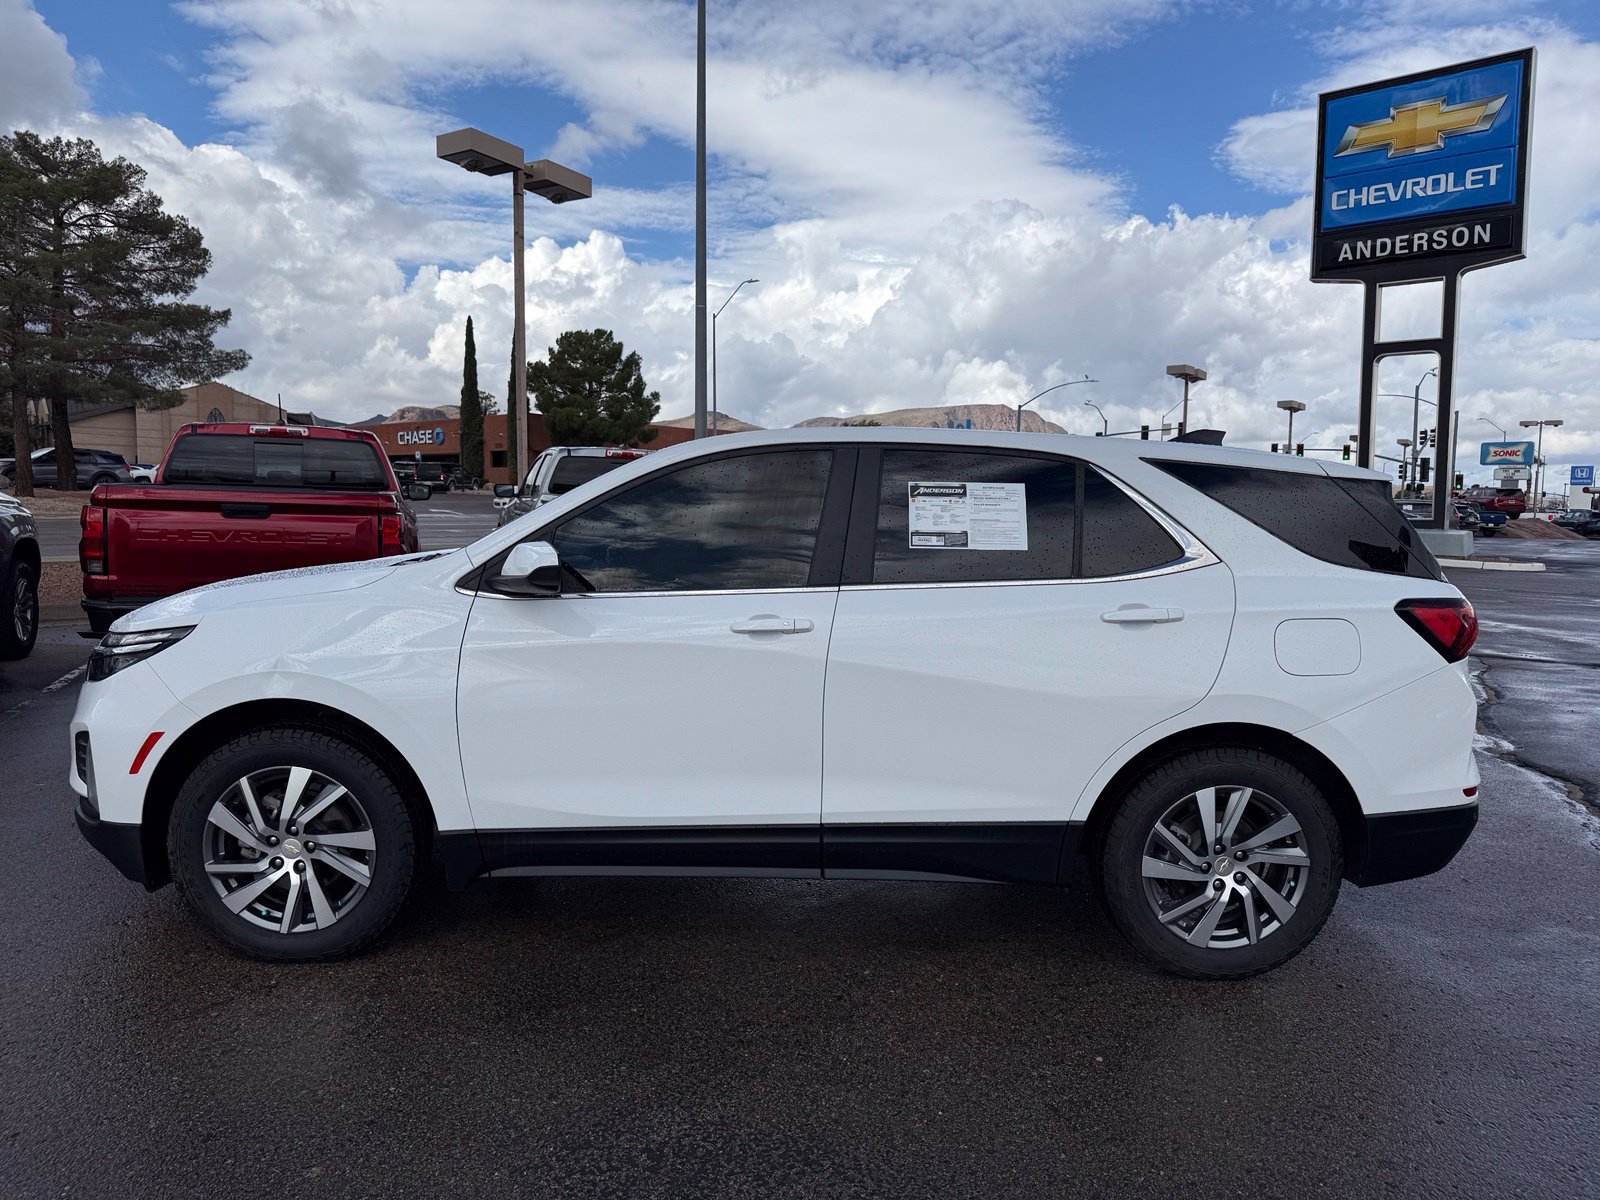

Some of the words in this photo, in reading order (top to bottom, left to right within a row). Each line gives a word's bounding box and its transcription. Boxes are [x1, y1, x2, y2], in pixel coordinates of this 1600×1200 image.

[1331, 163, 1504, 212] CHEVROLET
[1338, 223, 1492, 262] ANDERSON
[397, 429, 433, 445] CHASE
[912, 487, 965, 496] ANDERSON
[136, 528, 350, 545] CHEVROLET
